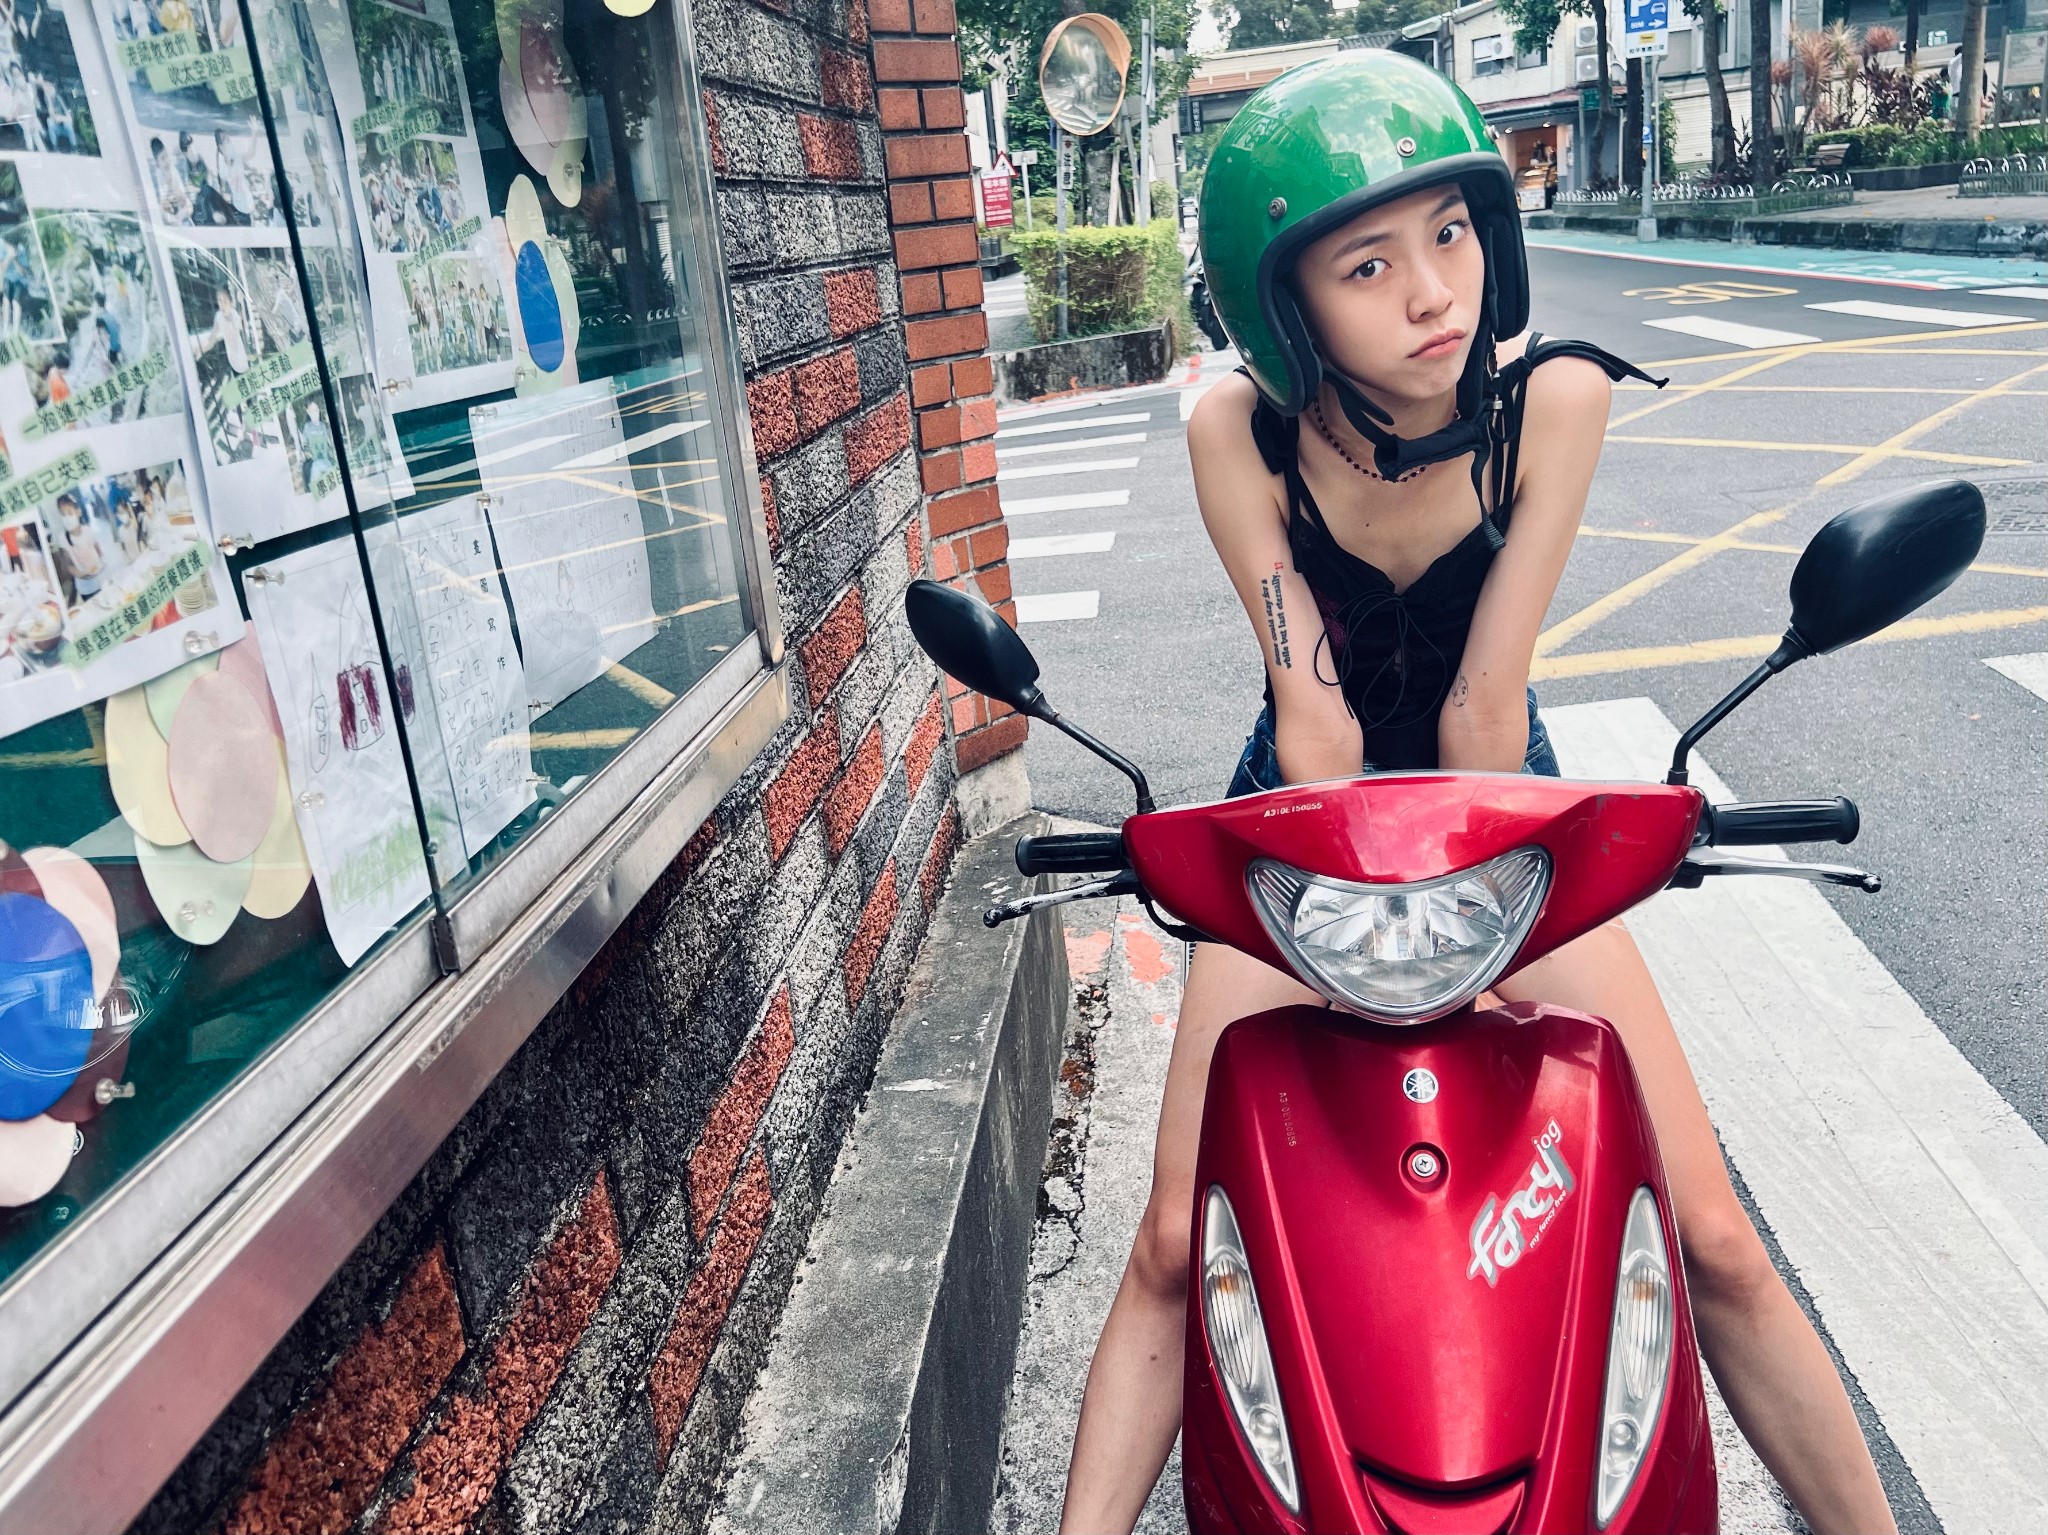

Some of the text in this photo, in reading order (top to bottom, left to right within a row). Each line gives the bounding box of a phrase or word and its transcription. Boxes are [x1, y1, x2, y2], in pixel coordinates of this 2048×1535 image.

[1268, 618, 1277, 641] could
[1277, 612, 1286, 628] last
[1280, 629, 1288, 645] but
[1281, 646, 1292, 669] while
[1529, 1189, 1567, 1249] my fancy free
